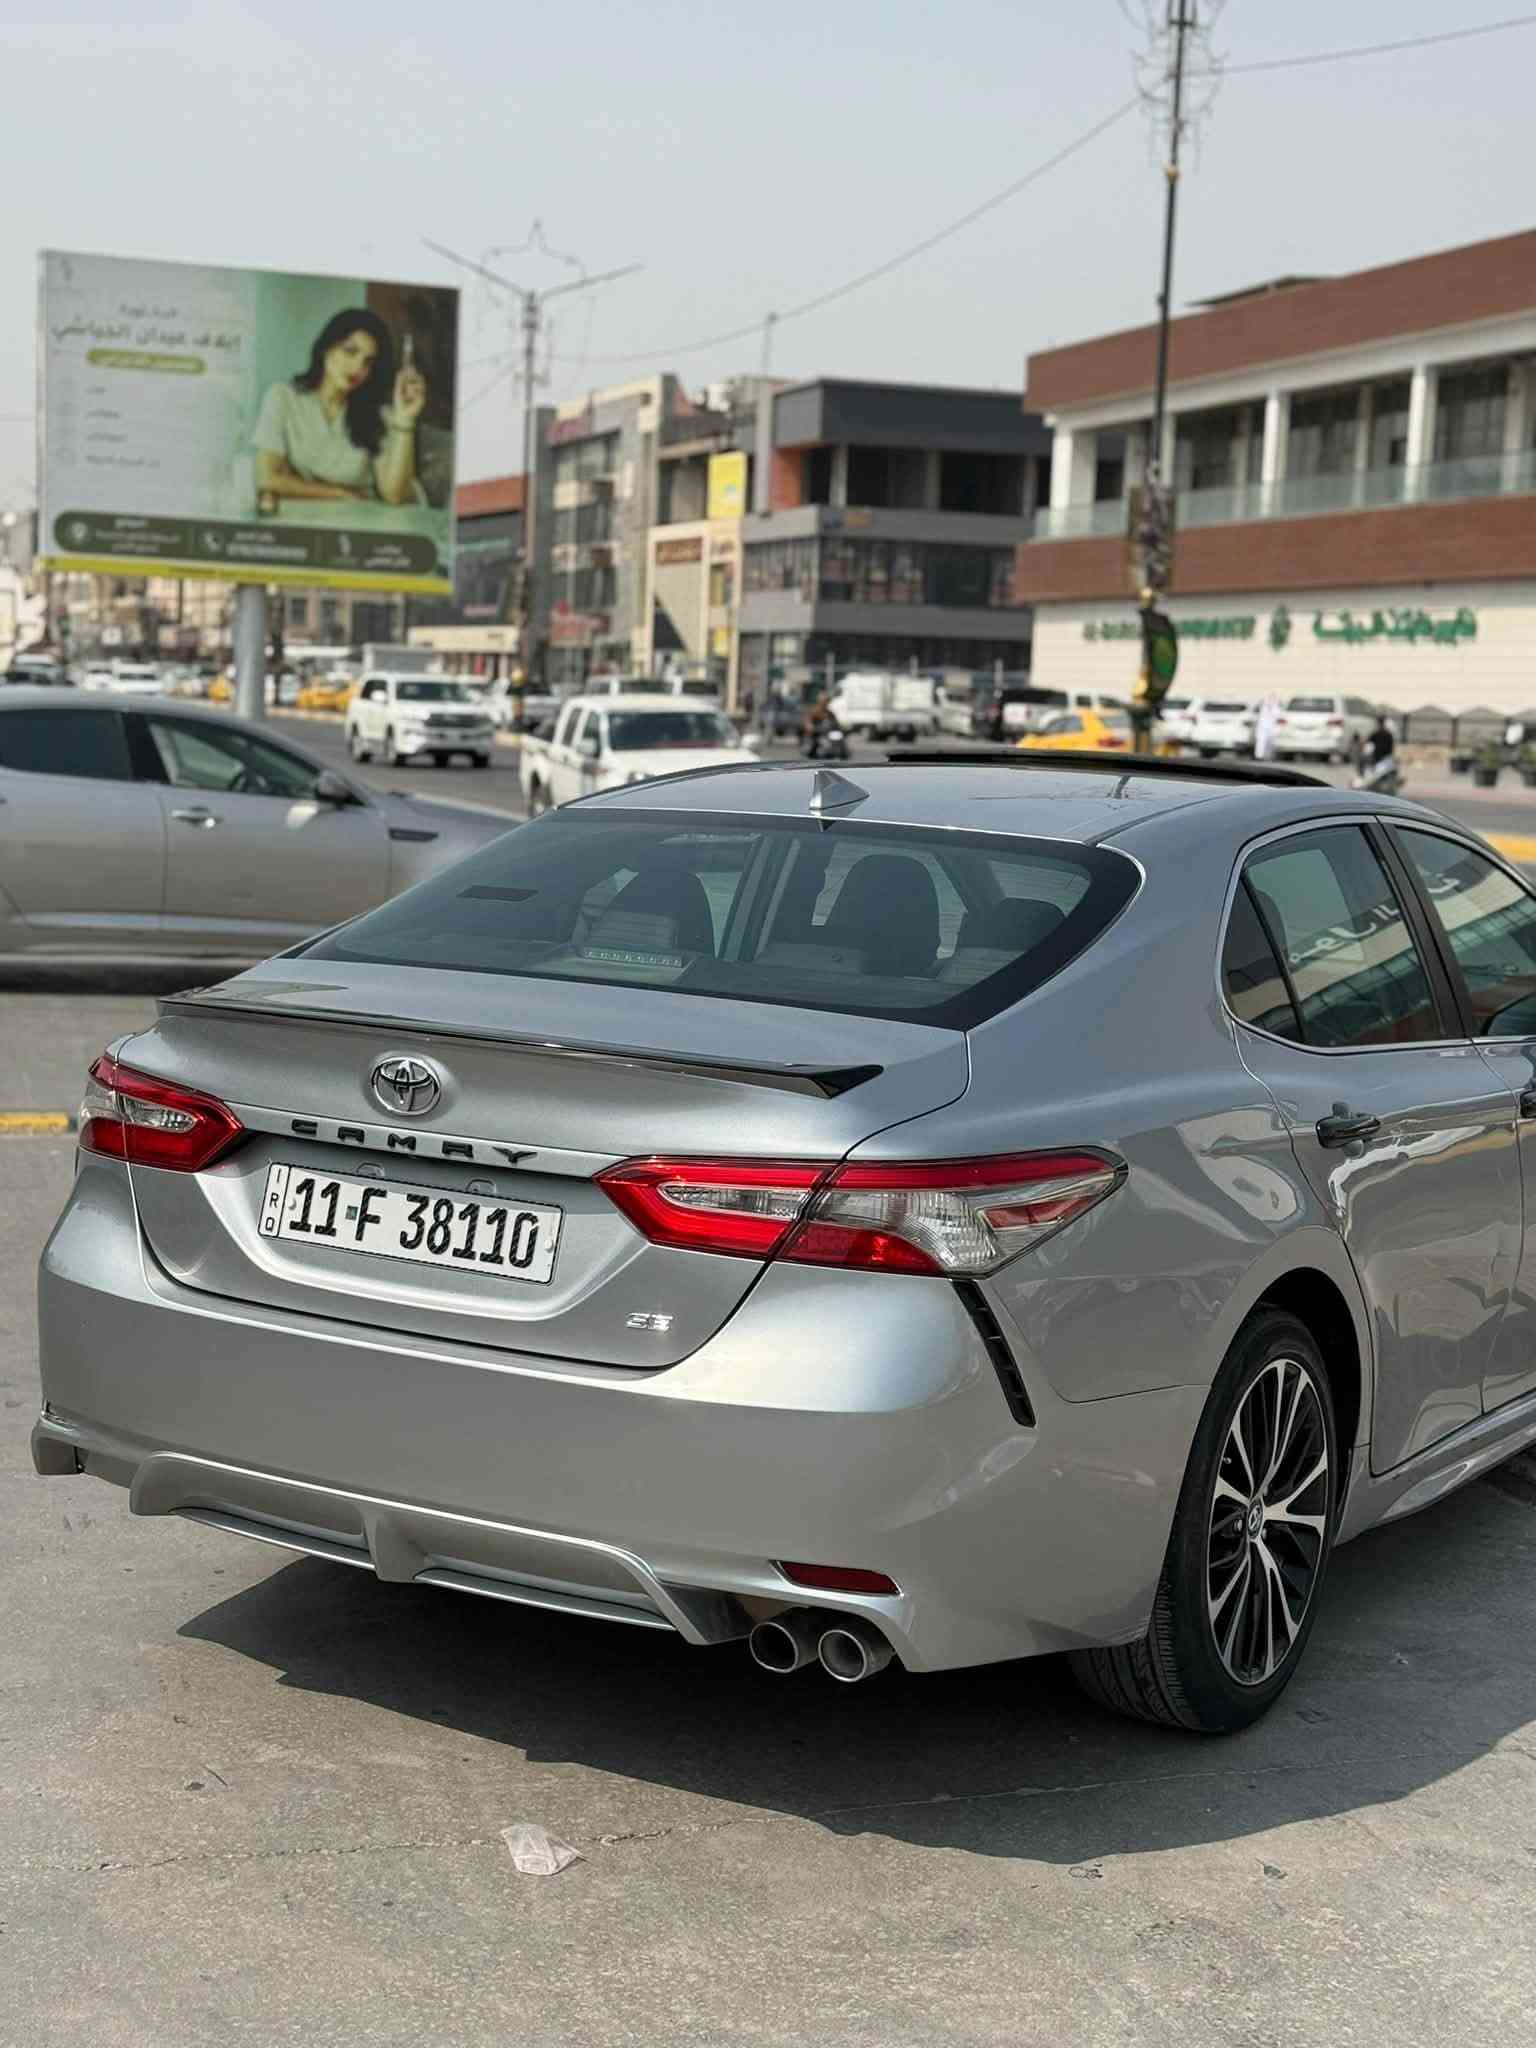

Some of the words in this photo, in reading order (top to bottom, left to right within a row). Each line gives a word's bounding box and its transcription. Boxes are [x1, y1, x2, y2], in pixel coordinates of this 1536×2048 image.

[291, 1118, 539, 1164] CAMRY
[264, 1166, 283, 1232] IRQ
[288, 1176, 341, 1238] 11
[355, 1187, 388, 1241] F
[399, 1192, 540, 1269] 38110
[624, 1311, 676, 1332] SE
